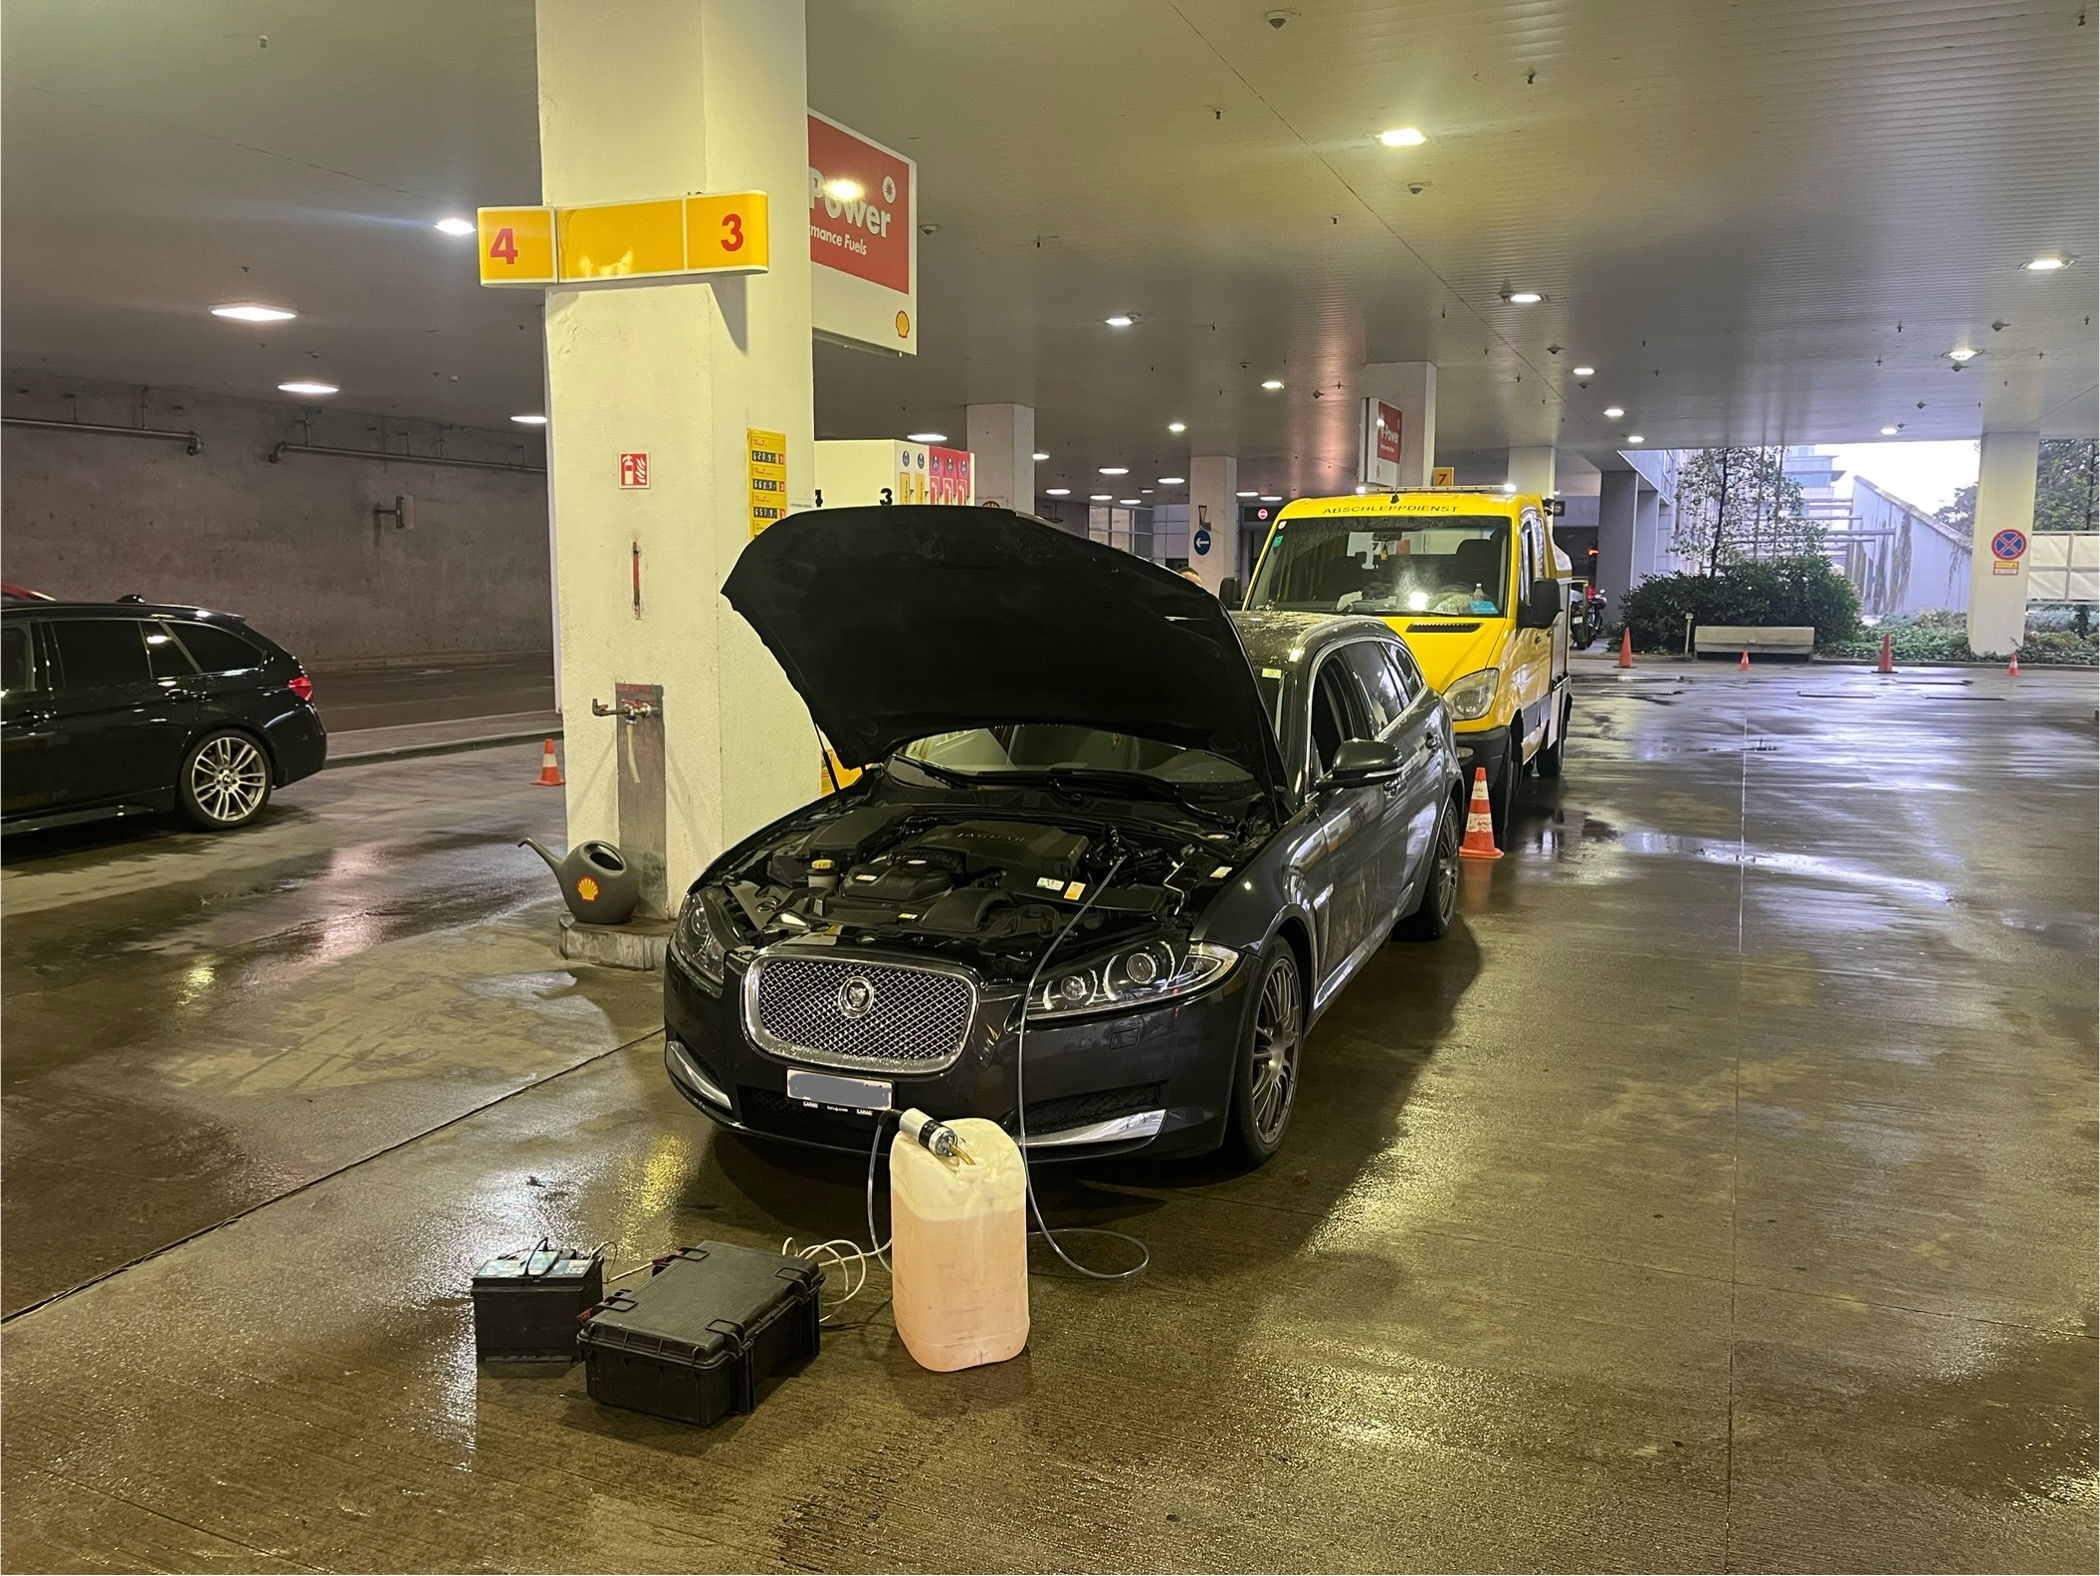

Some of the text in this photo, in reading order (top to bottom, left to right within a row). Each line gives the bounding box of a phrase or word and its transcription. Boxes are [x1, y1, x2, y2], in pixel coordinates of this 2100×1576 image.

[720, 213, 744, 252] 3
[490, 228, 519, 265] 4
[844, 234, 867, 256] Fuels
[1438, 473, 1448, 485] 7
[879, 488, 893, 506] 3
[1322, 505, 1460, 514] ABSCHLEPPDIENST
